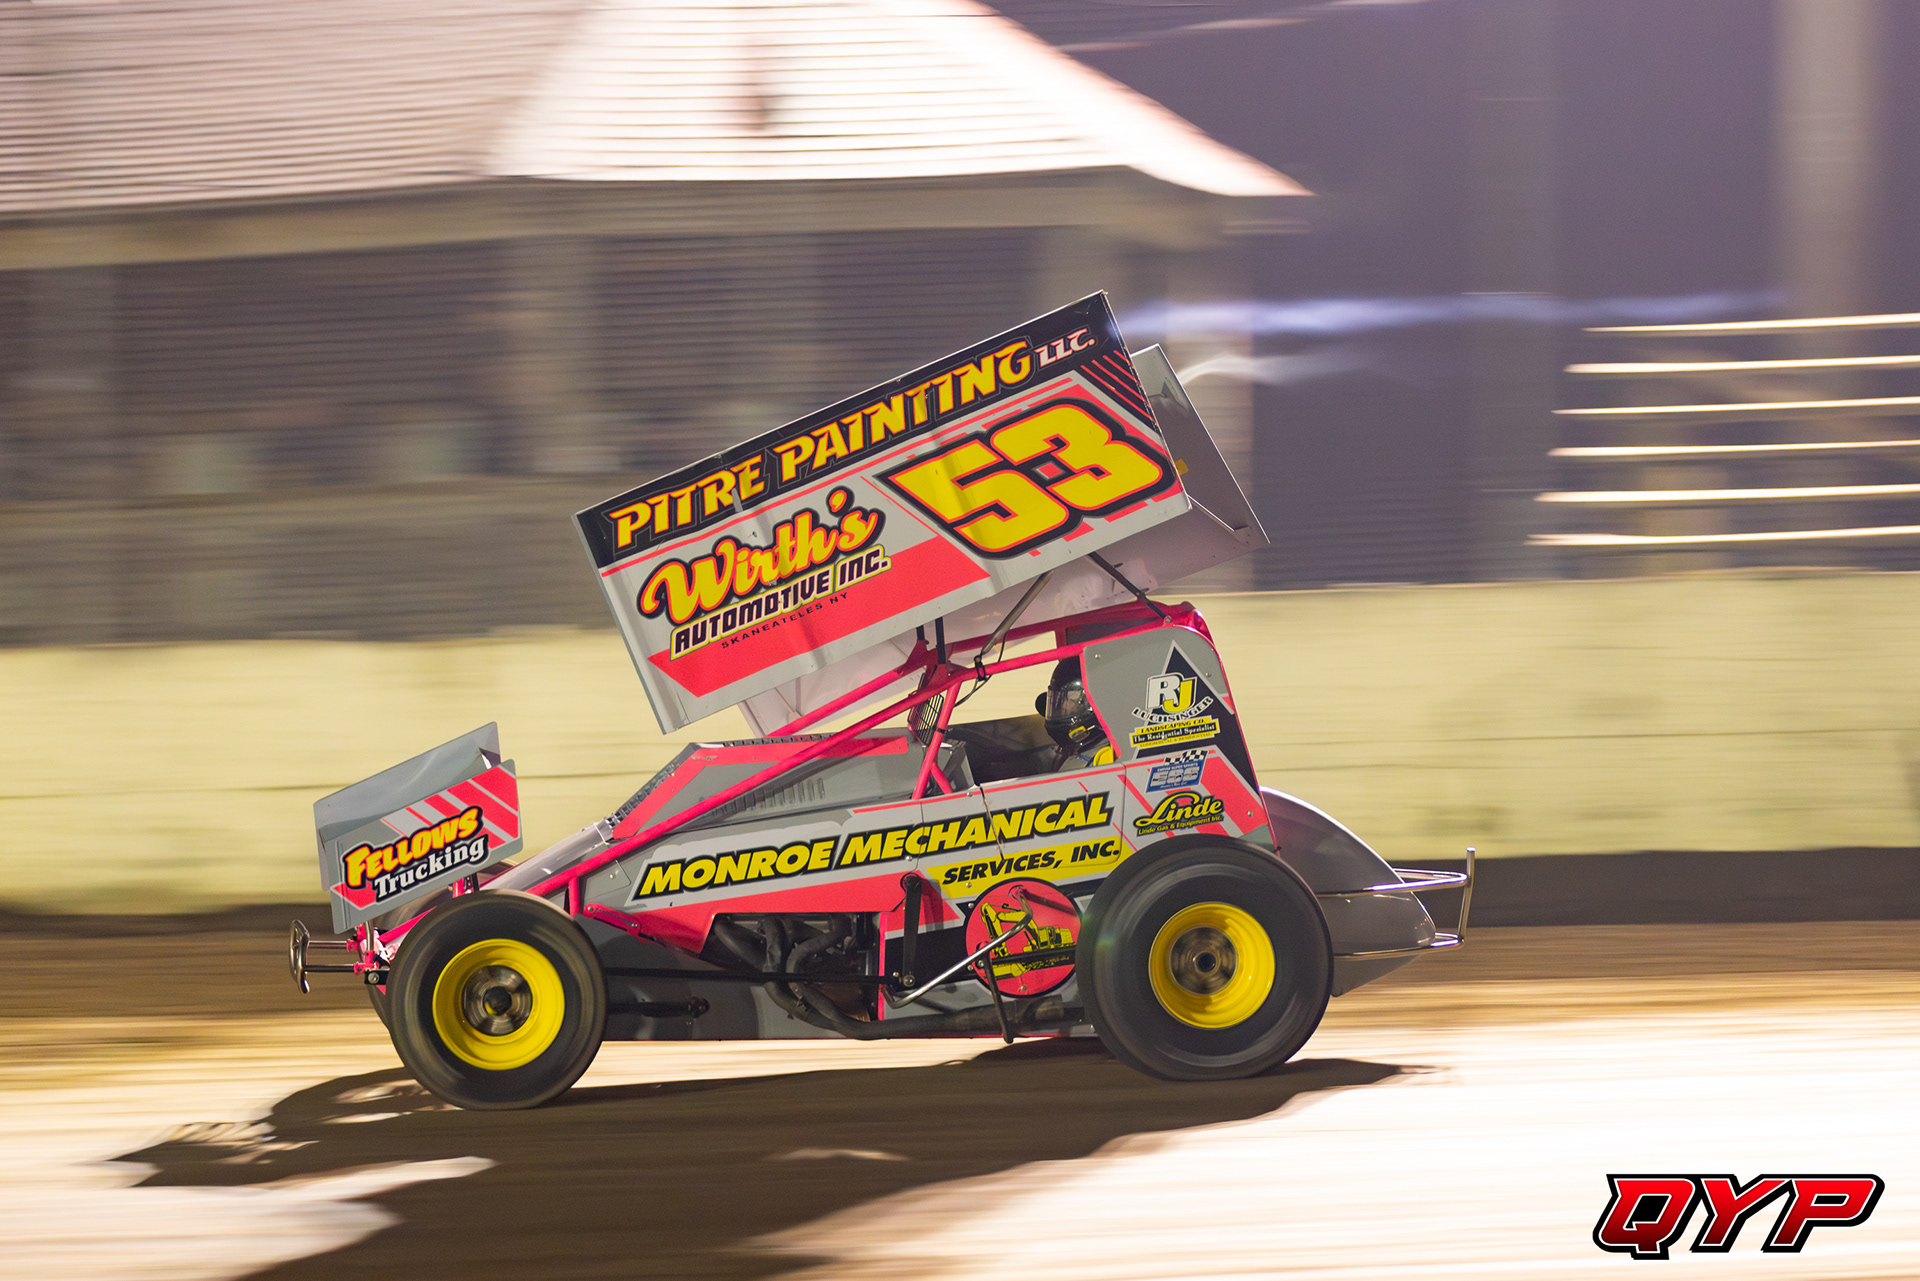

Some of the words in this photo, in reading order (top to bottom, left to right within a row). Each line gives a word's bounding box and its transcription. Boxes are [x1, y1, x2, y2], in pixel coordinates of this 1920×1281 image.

[609, 454, 766, 549] PITRE
[772, 340, 1031, 483] PAINTING
[1034, 328, 1096, 368] LLC.
[887, 403, 1164, 553] 53
[640, 488, 879, 623] Wirth's
[674, 569, 831, 654] AUTOMOTIVE
[838, 548, 889, 587] INC.
[721, 603, 823, 649] SKANEATELES
[829, 592, 848, 605] NY
[1133, 697, 1213, 723] LUCHSINGER
[1147, 673, 1195, 714] RJ
[1132, 735, 1146, 743] The
[1184, 723, 1215, 735] Specialist
[1141, 722, 1192, 734] LANDSCAPING
[1135, 792, 1223, 827] Linde
[1176, 816, 1211, 828] Equipment
[344, 807, 479, 888] FELLOWS
[375, 836, 487, 899] Trucking
[639, 839, 835, 896] MONROE
[840, 796, 1112, 866] MECHANICAL
[942, 850, 1064, 886] SERVICES,
[1070, 840, 1120, 863] INC.
